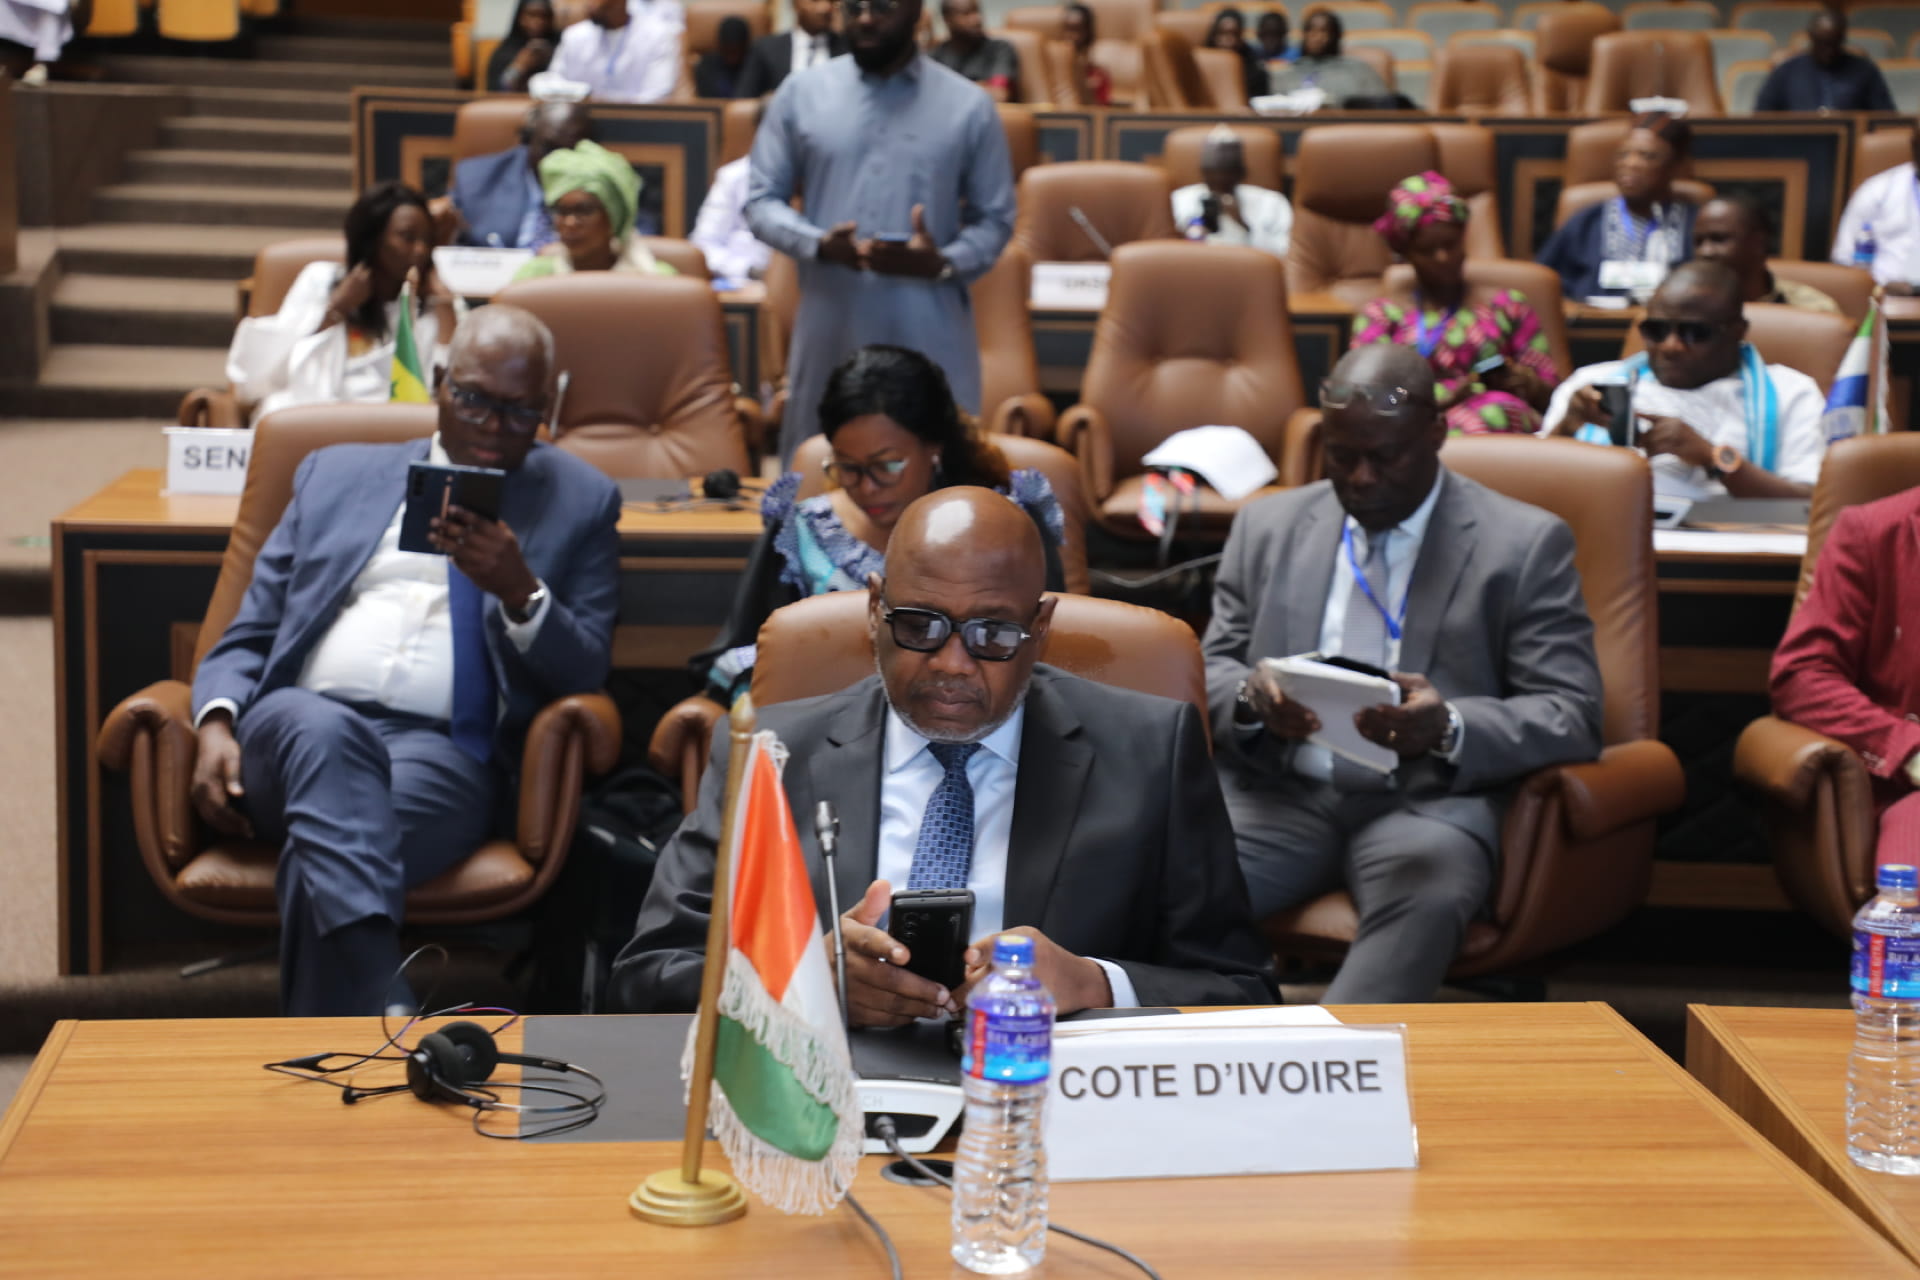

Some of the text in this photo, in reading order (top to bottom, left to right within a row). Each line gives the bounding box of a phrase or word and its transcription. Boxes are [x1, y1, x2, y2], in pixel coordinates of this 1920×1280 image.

[183, 445, 247, 470] SEN
[1059, 1059, 1382, 1100] COTE D’IVOIRE
